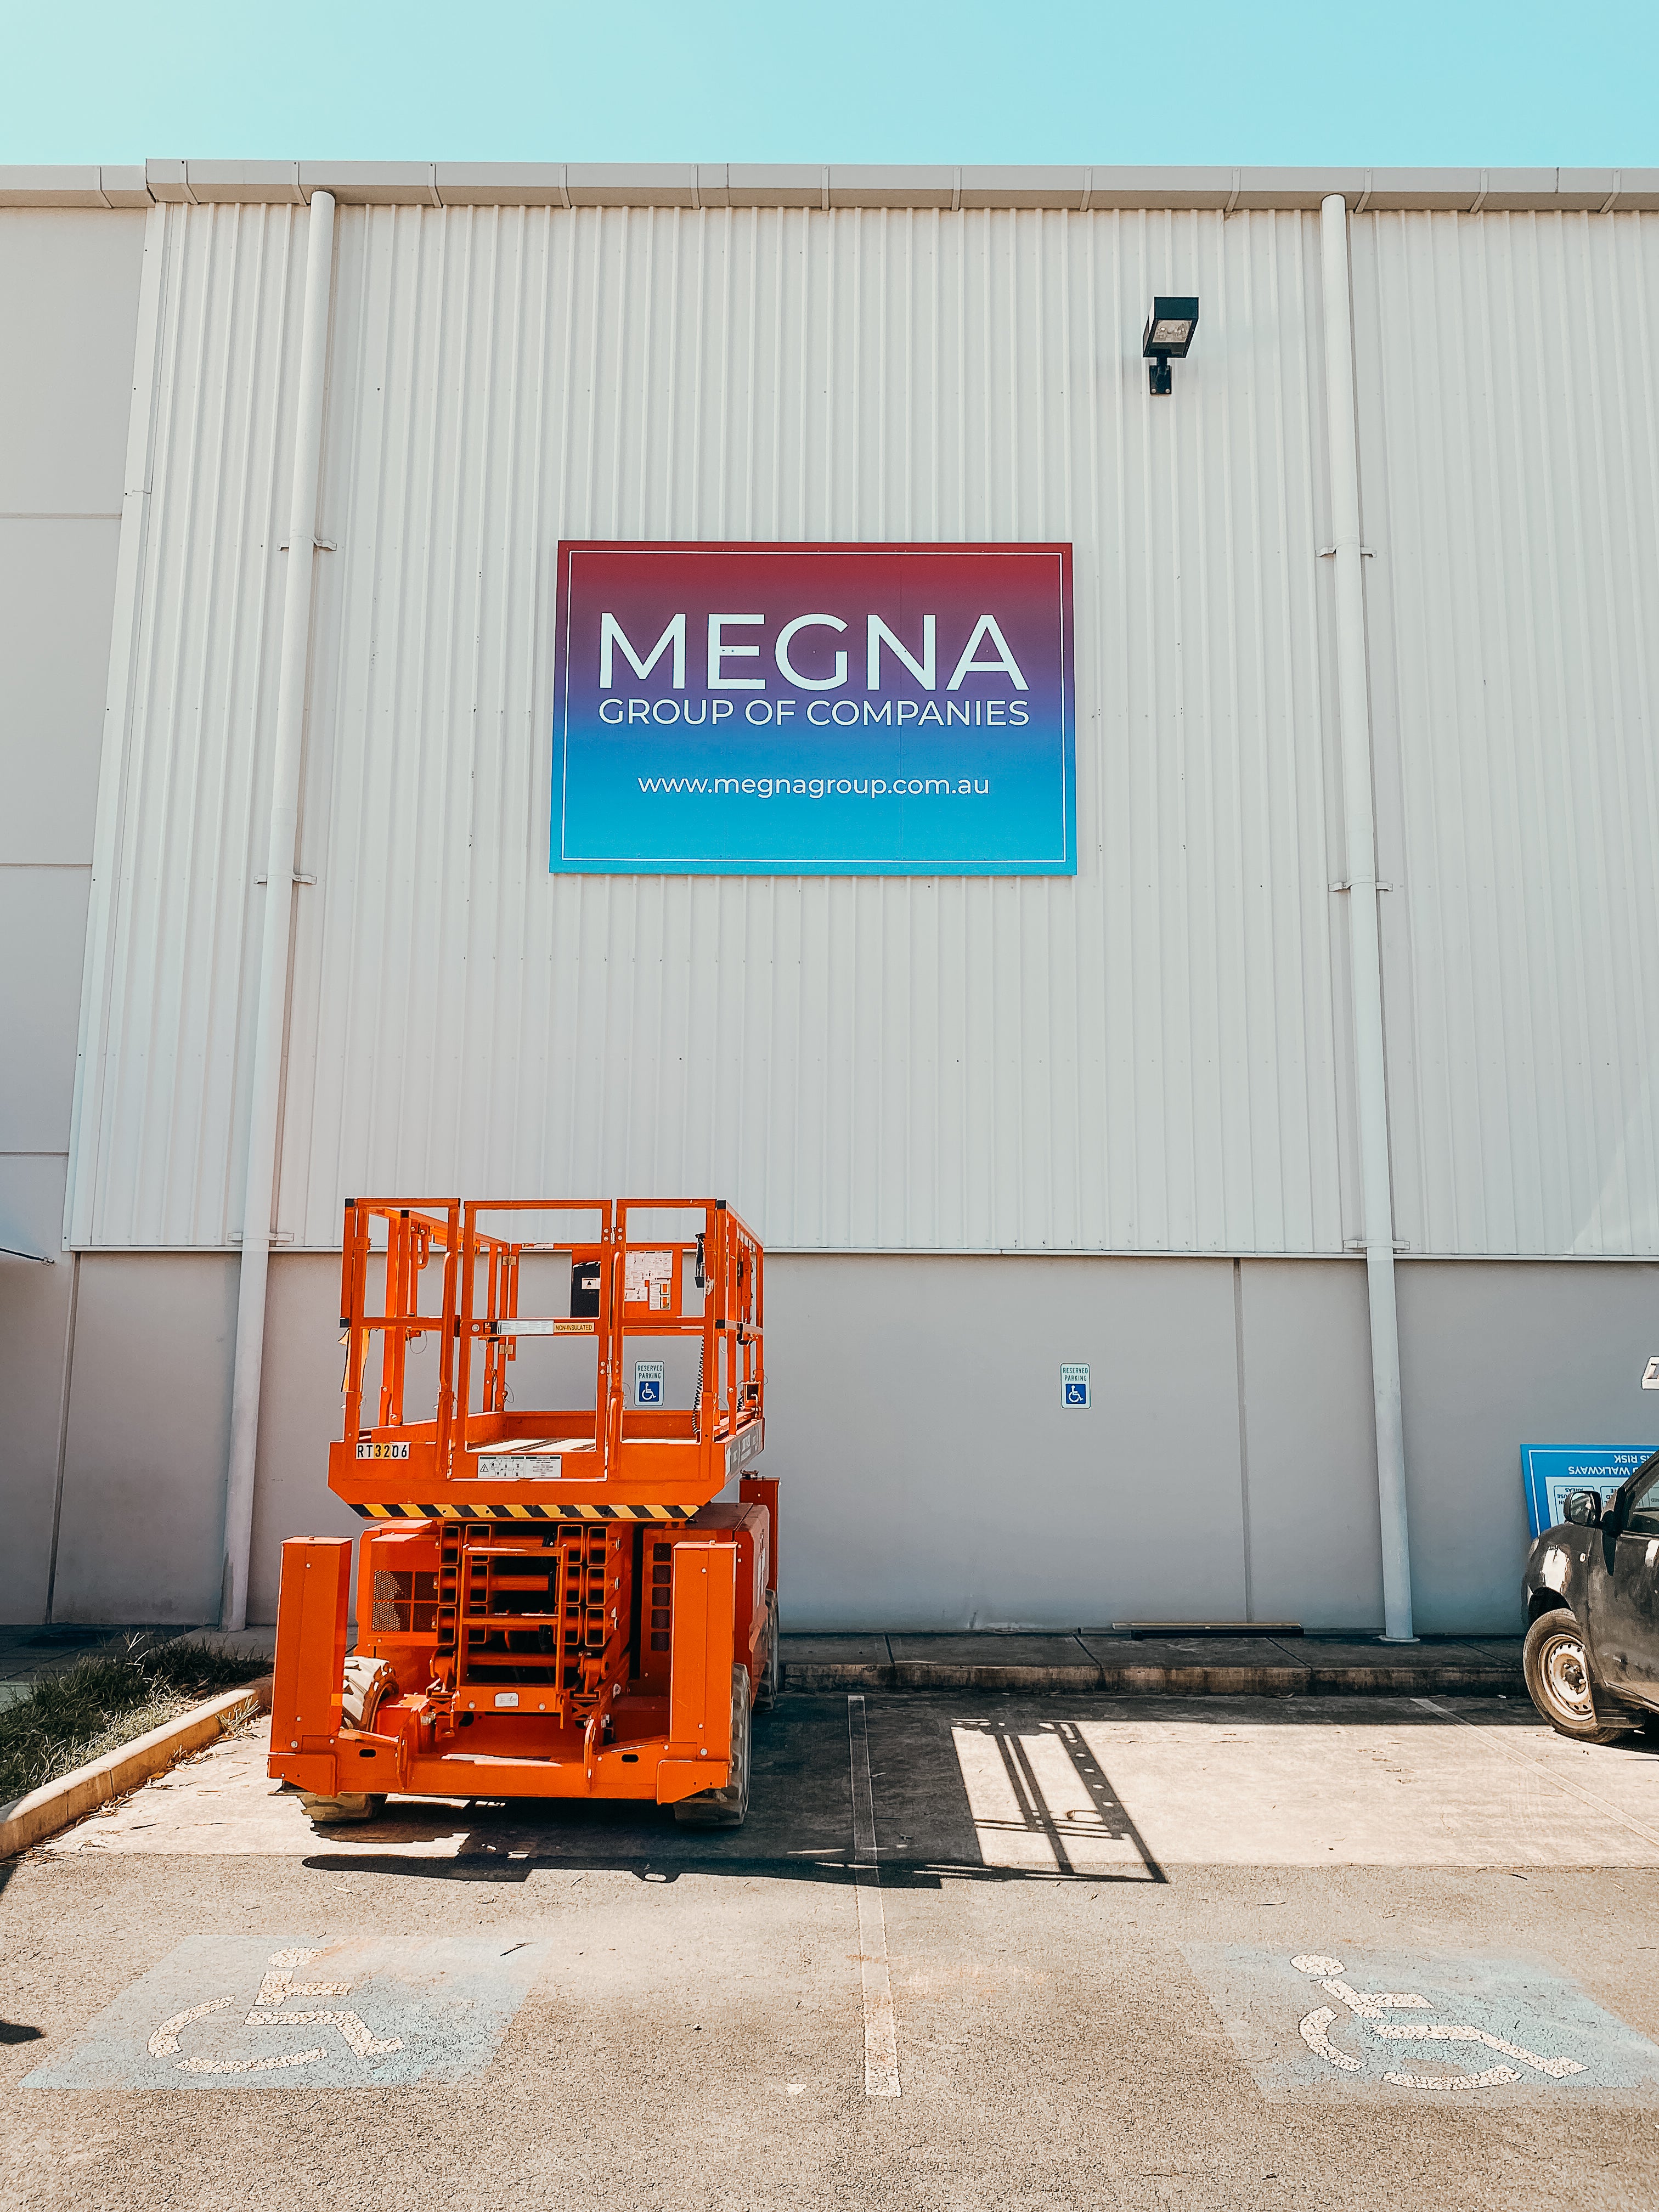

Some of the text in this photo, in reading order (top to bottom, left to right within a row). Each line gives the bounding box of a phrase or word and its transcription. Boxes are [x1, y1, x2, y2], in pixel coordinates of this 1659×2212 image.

[599, 611, 1029, 691] MEGNA
[599, 698, 1029, 726] GROUP OF COMPANIES
[637, 776, 989, 799] www.megnagroup.com.au
[357, 1444, 407, 1458] RT3206
[1613, 1454, 1638, 1463] RISK
[1568, 1466, 1630, 1475] WALKWAYS
